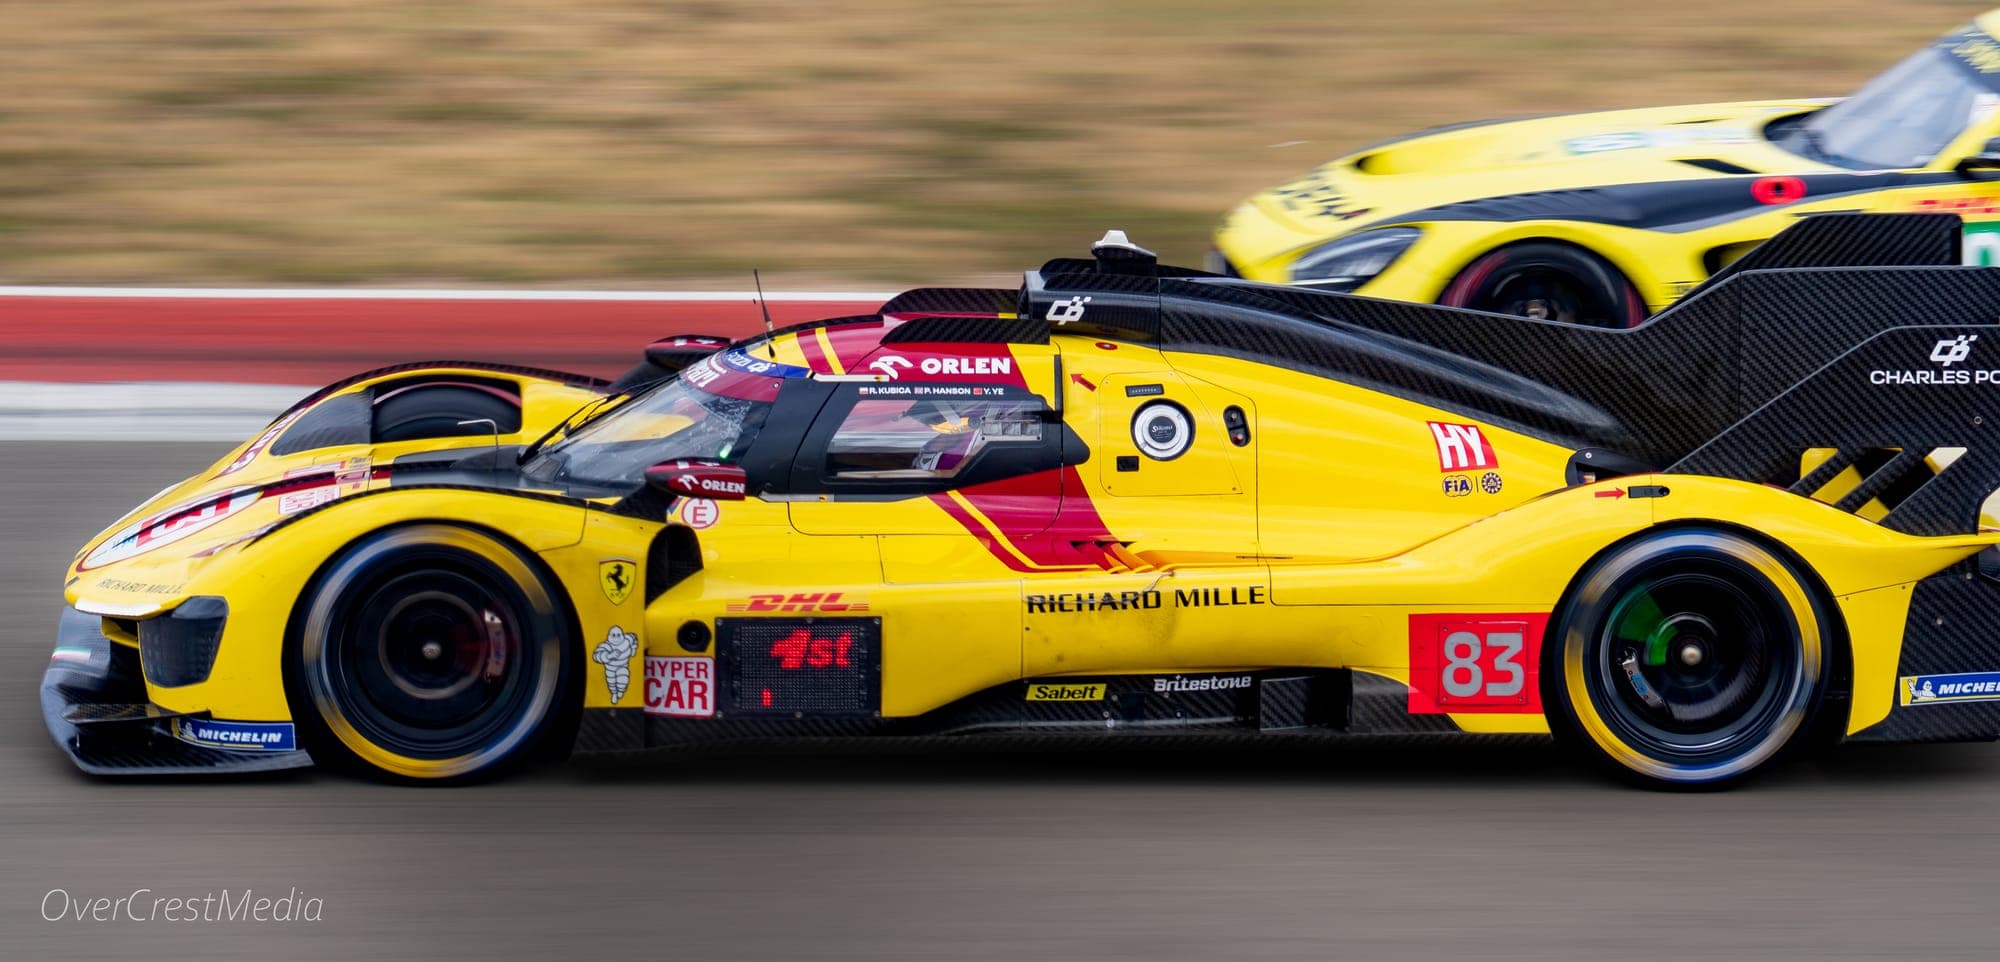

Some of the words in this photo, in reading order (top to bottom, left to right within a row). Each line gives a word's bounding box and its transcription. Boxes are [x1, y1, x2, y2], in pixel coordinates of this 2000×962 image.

[920, 357, 1011, 375] ORLEN
[1870, 370, 1970, 385] CHARLES
[1430, 422, 1487, 469] HY
[701, 479, 745, 493] ORLEN
[745, 592, 850, 612] DHL
[1027, 589, 1162, 614] RICHARD
[1174, 585, 1266, 609] MILLE
[644, 661, 709, 679] HYPER
[1441, 631, 1525, 698] 83
[1153, 674, 1252, 692] Britestone
[644, 680, 708, 711] CAR
[1034, 685, 1098, 700] Sabelt
[198, 726, 282, 744] MICHELIN
